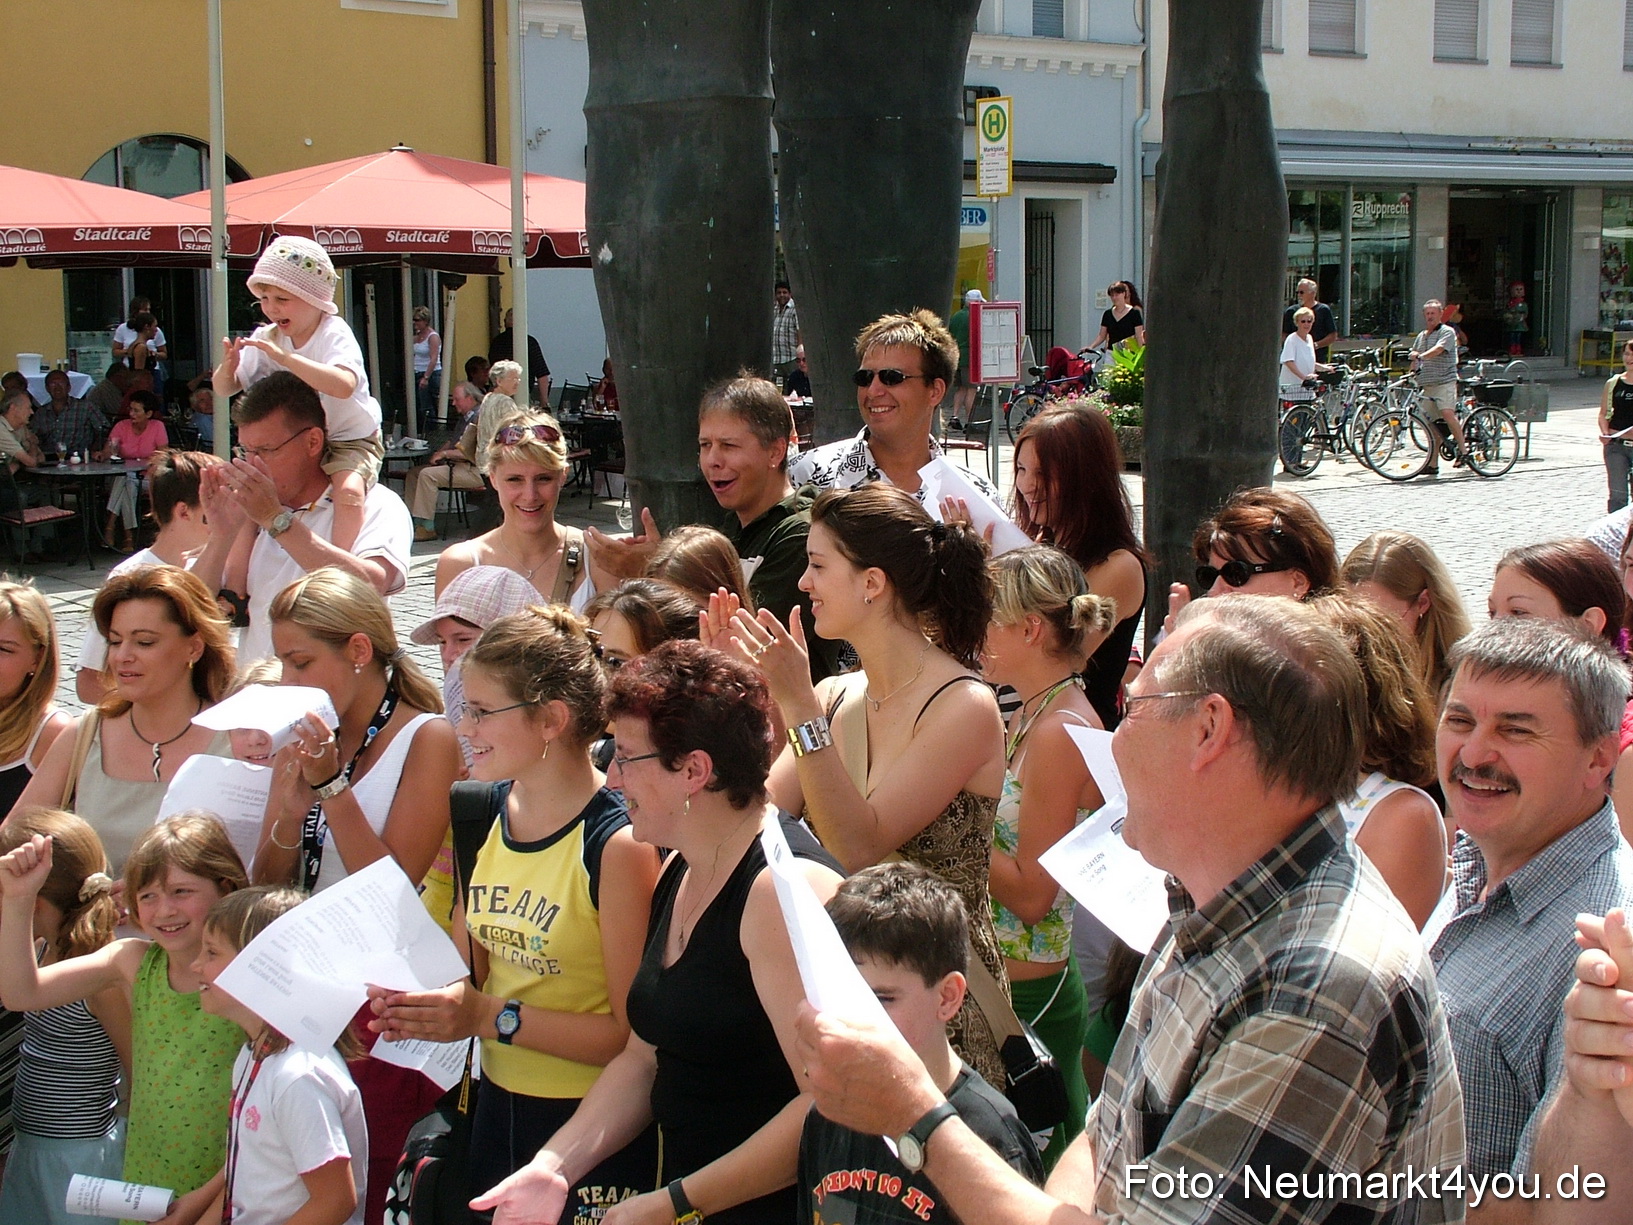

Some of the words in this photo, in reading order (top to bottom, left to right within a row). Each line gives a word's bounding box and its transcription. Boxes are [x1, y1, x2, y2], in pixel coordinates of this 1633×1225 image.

[1364, 200, 1409, 218] Rupprecht
[73, 227, 151, 241] Stadtcafé
[386, 229, 450, 243] Stadtcafé
[305, 800, 321, 838] ITALIA
[469, 885, 561, 933] TEAM
[486, 926, 523, 947] 1984
[577, 1185, 639, 1205] TEAM
[878, 1173, 902, 1197] DO
